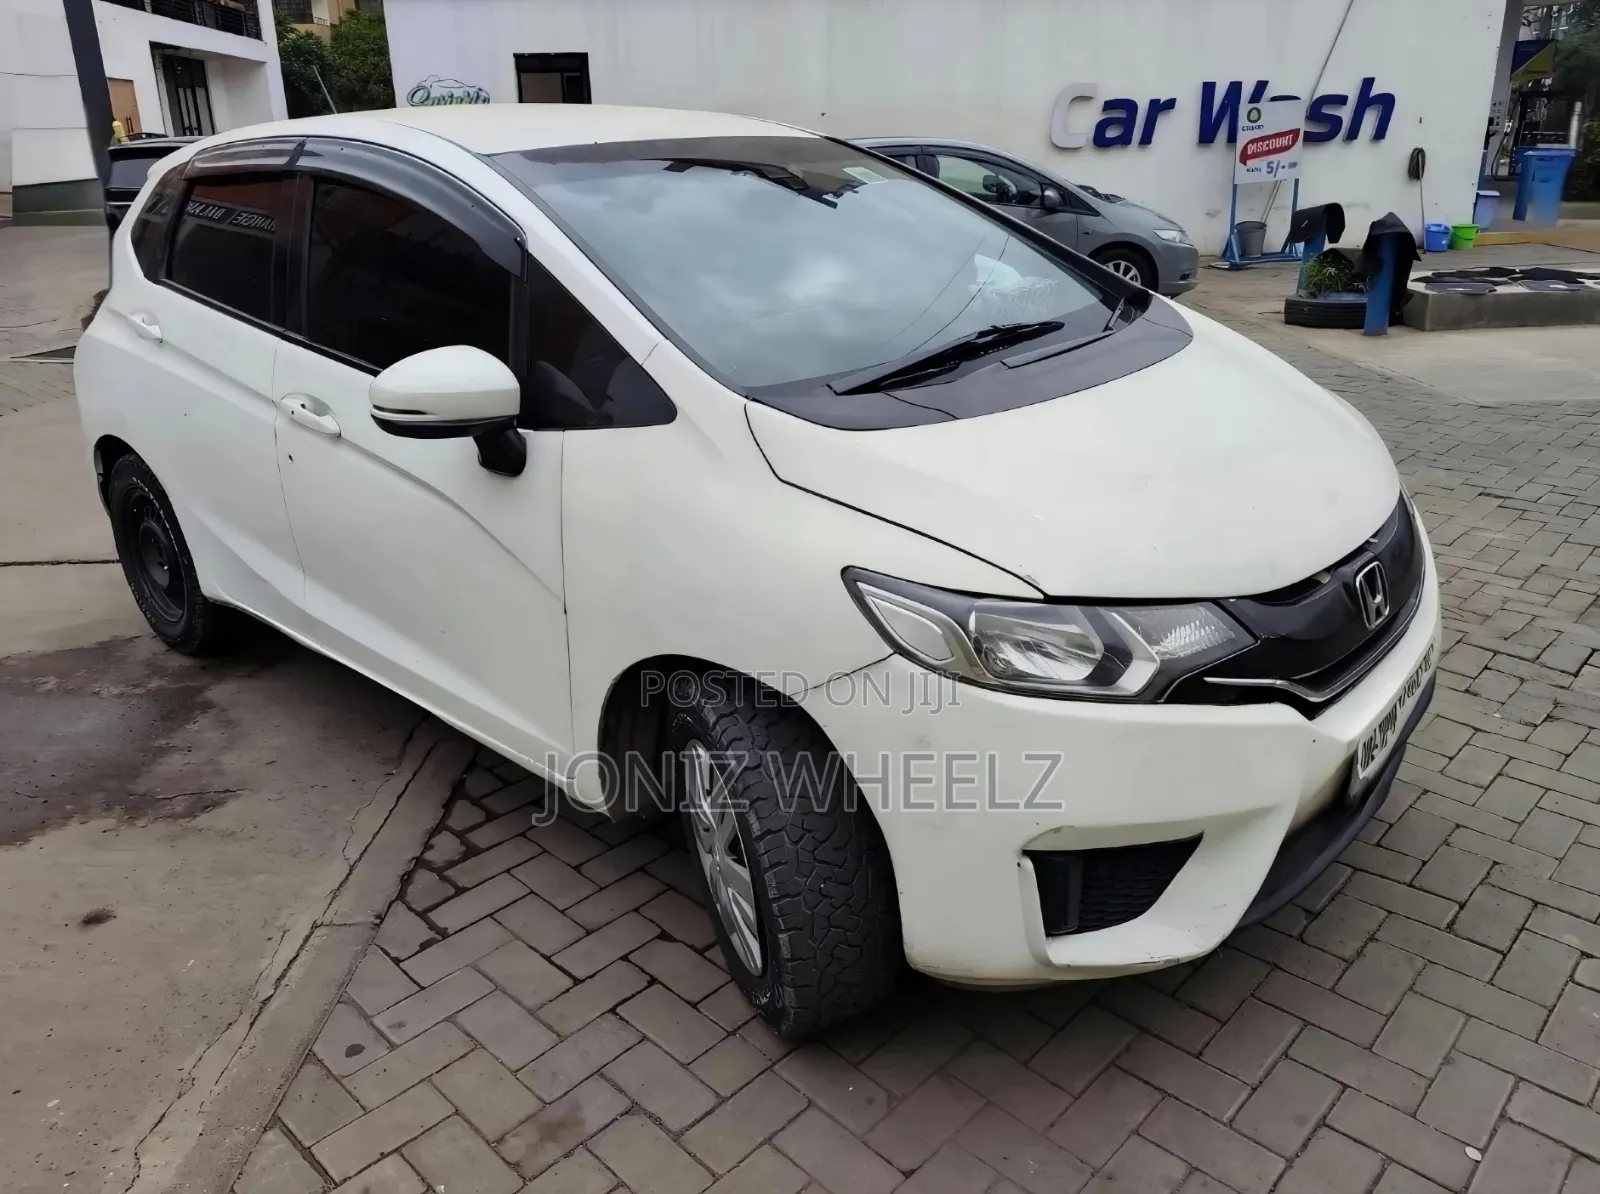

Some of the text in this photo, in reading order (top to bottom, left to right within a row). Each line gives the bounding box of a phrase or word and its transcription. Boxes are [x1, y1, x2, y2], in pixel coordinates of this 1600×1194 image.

[1050, 76, 1396, 148] Car Wsh
[1247, 134, 1294, 155] DISCOUNT
